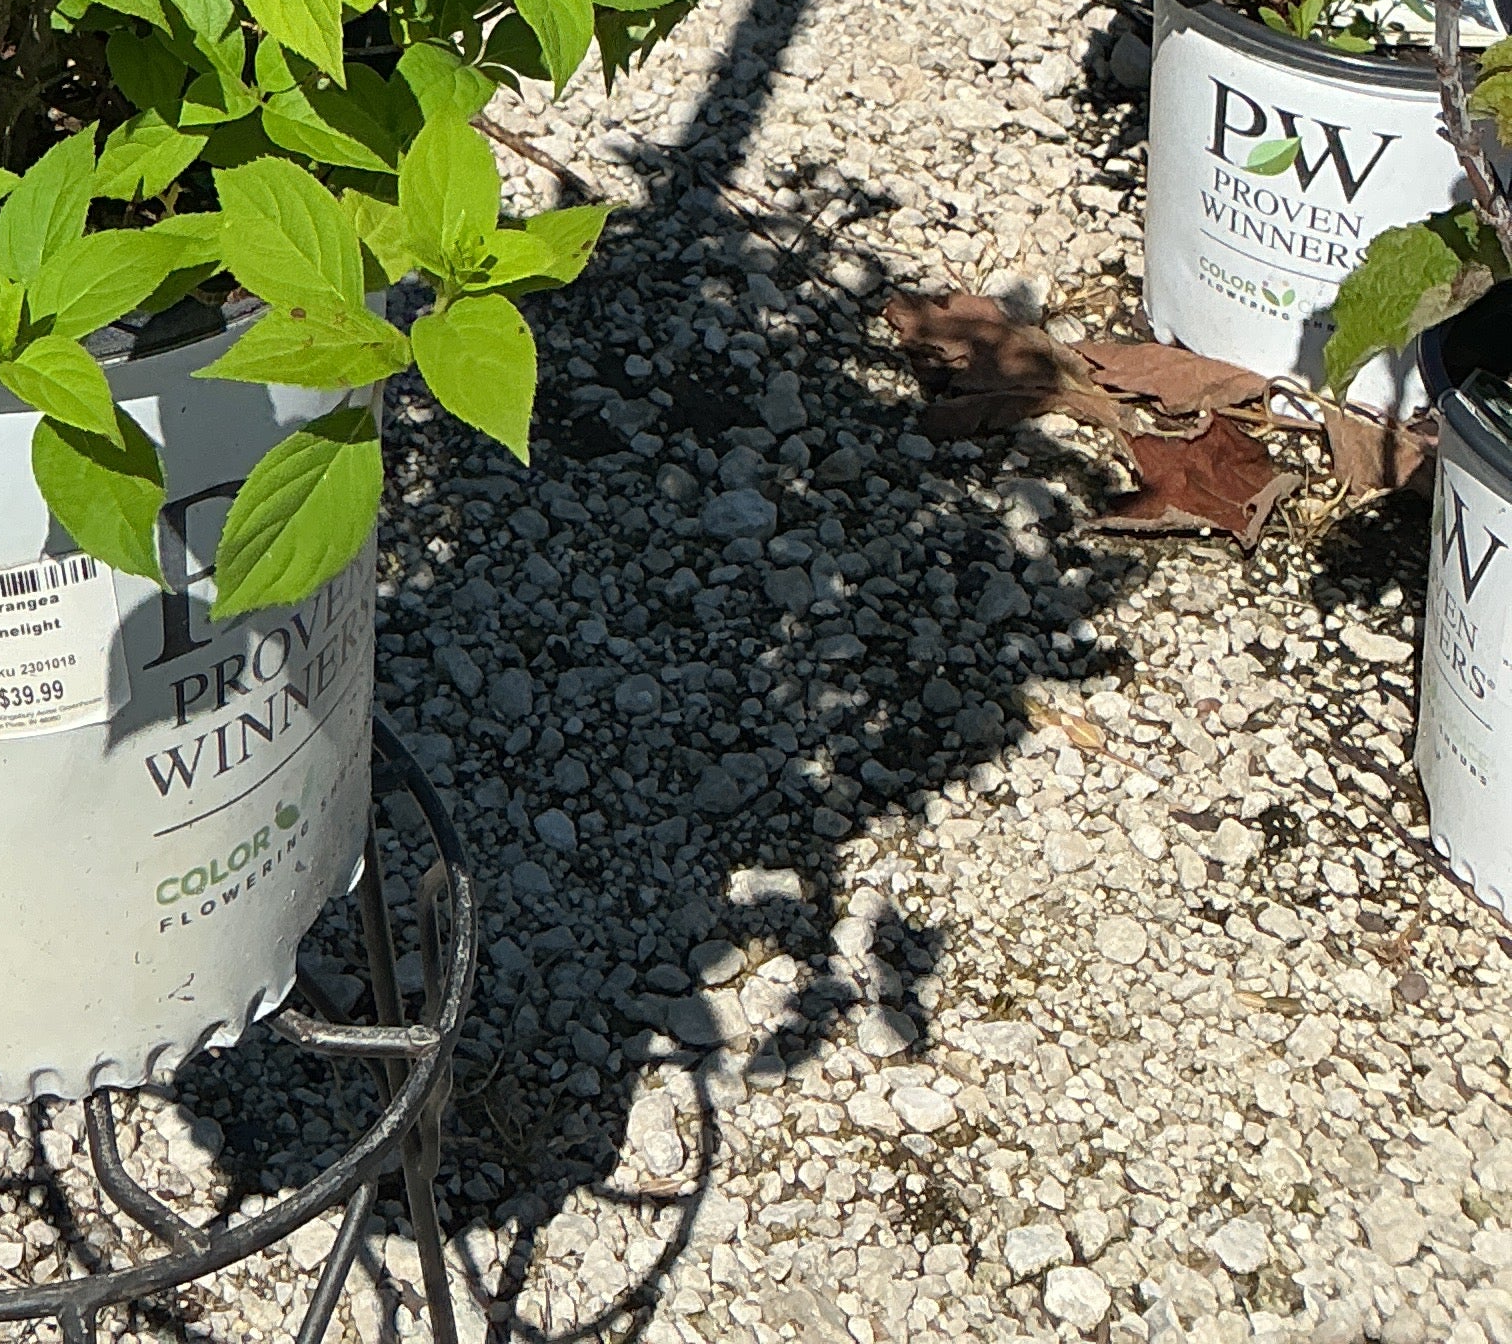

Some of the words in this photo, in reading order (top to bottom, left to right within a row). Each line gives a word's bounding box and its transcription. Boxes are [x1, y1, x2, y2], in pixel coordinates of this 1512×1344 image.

[1205, 76, 1402, 204] PW
[1213, 167, 1365, 240] PROVEN
[1199, 255, 1257, 297] COLOR
[1199, 272, 1291, 322] FLOWERING
[20, 654, 77, 676] 2301018
[156, 824, 272, 906] COLOR
[159, 819, 310, 934] FLOWERING
